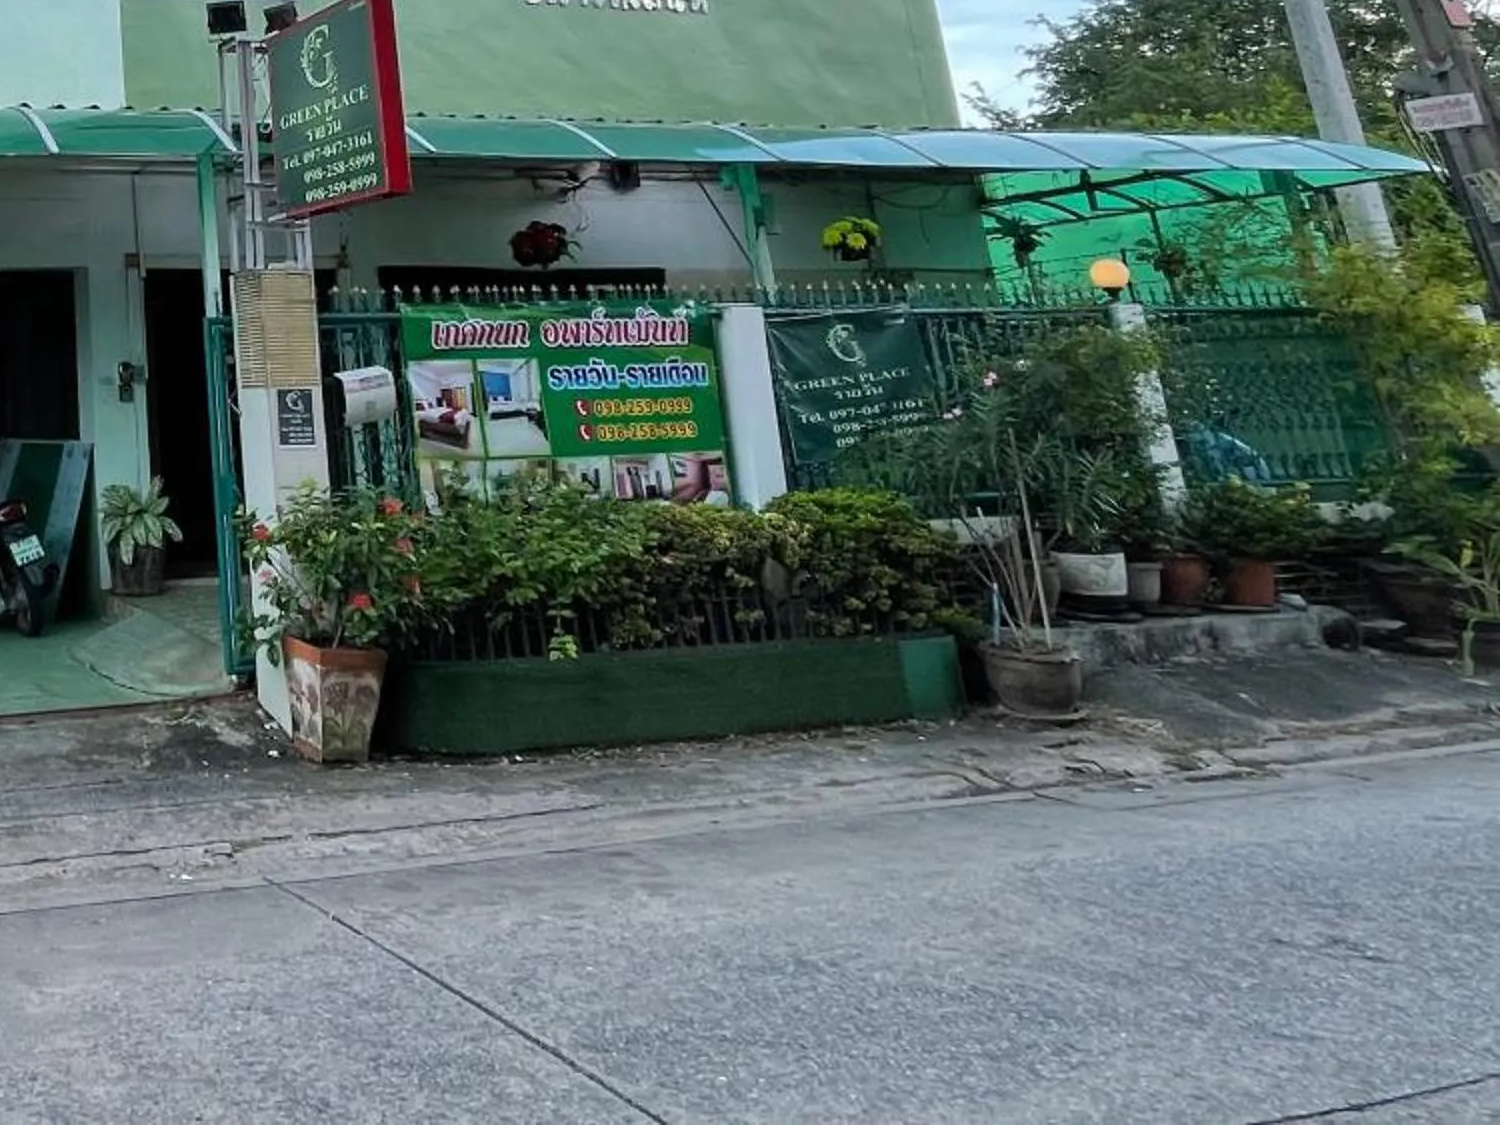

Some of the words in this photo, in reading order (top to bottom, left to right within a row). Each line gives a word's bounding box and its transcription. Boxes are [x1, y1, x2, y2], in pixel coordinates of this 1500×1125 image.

[280, 104, 321, 130] GREEN
[323, 84, 369, 114] PLACE
[548, 356, 709, 390] รายวัน-รายเดือน
[794, 375, 855, 391] GREEN
[859, 367, 910, 382] PLACE
[594, 397, 692, 417] 098-259-0999
